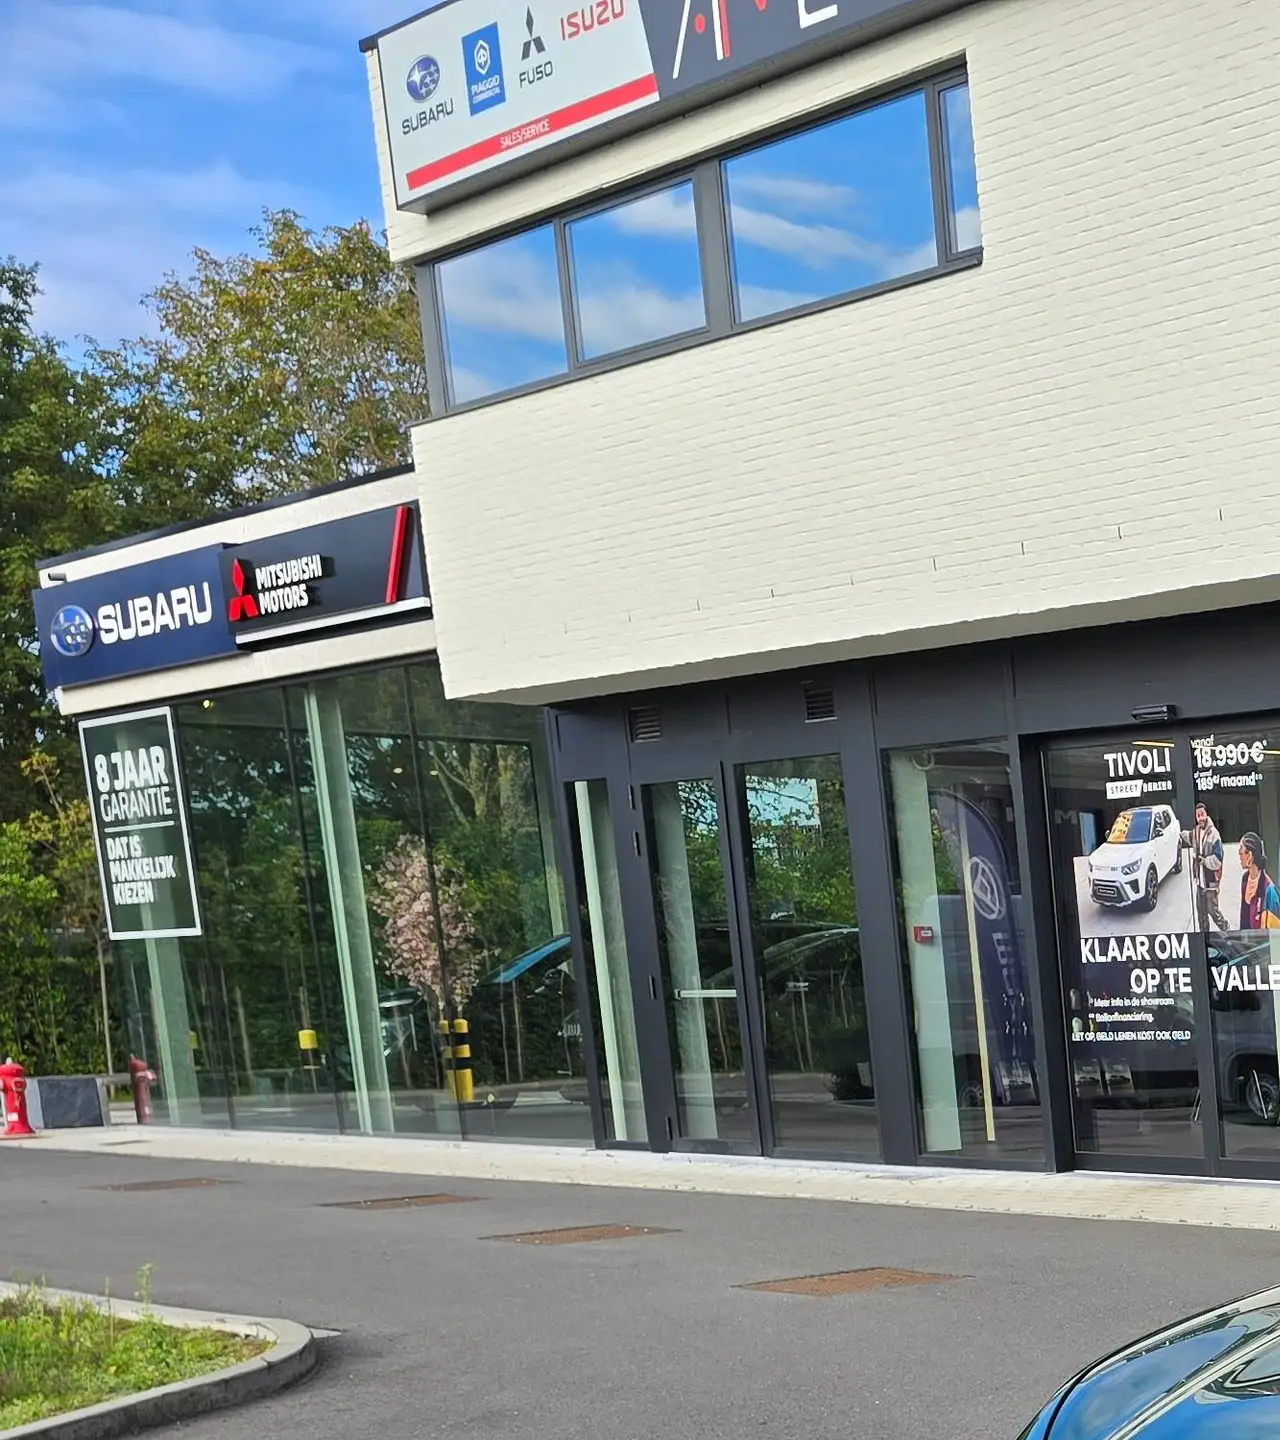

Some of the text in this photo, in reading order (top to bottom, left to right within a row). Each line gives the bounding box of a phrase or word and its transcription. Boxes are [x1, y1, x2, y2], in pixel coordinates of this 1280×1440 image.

[561, 0, 625, 41] ISUZU
[471, 75, 500, 95] PIAGGIO
[519, 61, 553, 88] FUSO
[402, 98, 454, 135] SUBARU
[500, 119, 550, 149] SALES/SERVICE
[256, 554, 323, 590] MITSUBISHI
[97, 581, 212, 644] SUBARU
[259, 589, 309, 615] MOTORS
[1191, 734, 1214, 748] vanaf
[94, 746, 169, 792] 8 JAAR
[1103, 748, 1171, 777] TIVOLI
[1110, 784, 1138, 795] STREET
[100, 786, 173, 822] GARANTIE
[106, 835, 142, 861] DAT IS
[109, 855, 176, 882] MAKKELIJK
[112, 881, 154, 905] KIEZEN
[1081, 934, 1190, 963] KLAAR OM
[1131, 968, 1160, 994] OP
[1165, 967, 1192, 992] TE
[1141, 996, 1174, 1006] showroom
[1096, 1031, 1114, 1040] GELD
[1137, 1031, 1154, 1040] KOST
[1156, 1031, 1171, 1040] OOK
[1172, 1031, 1191, 1040] GELD
